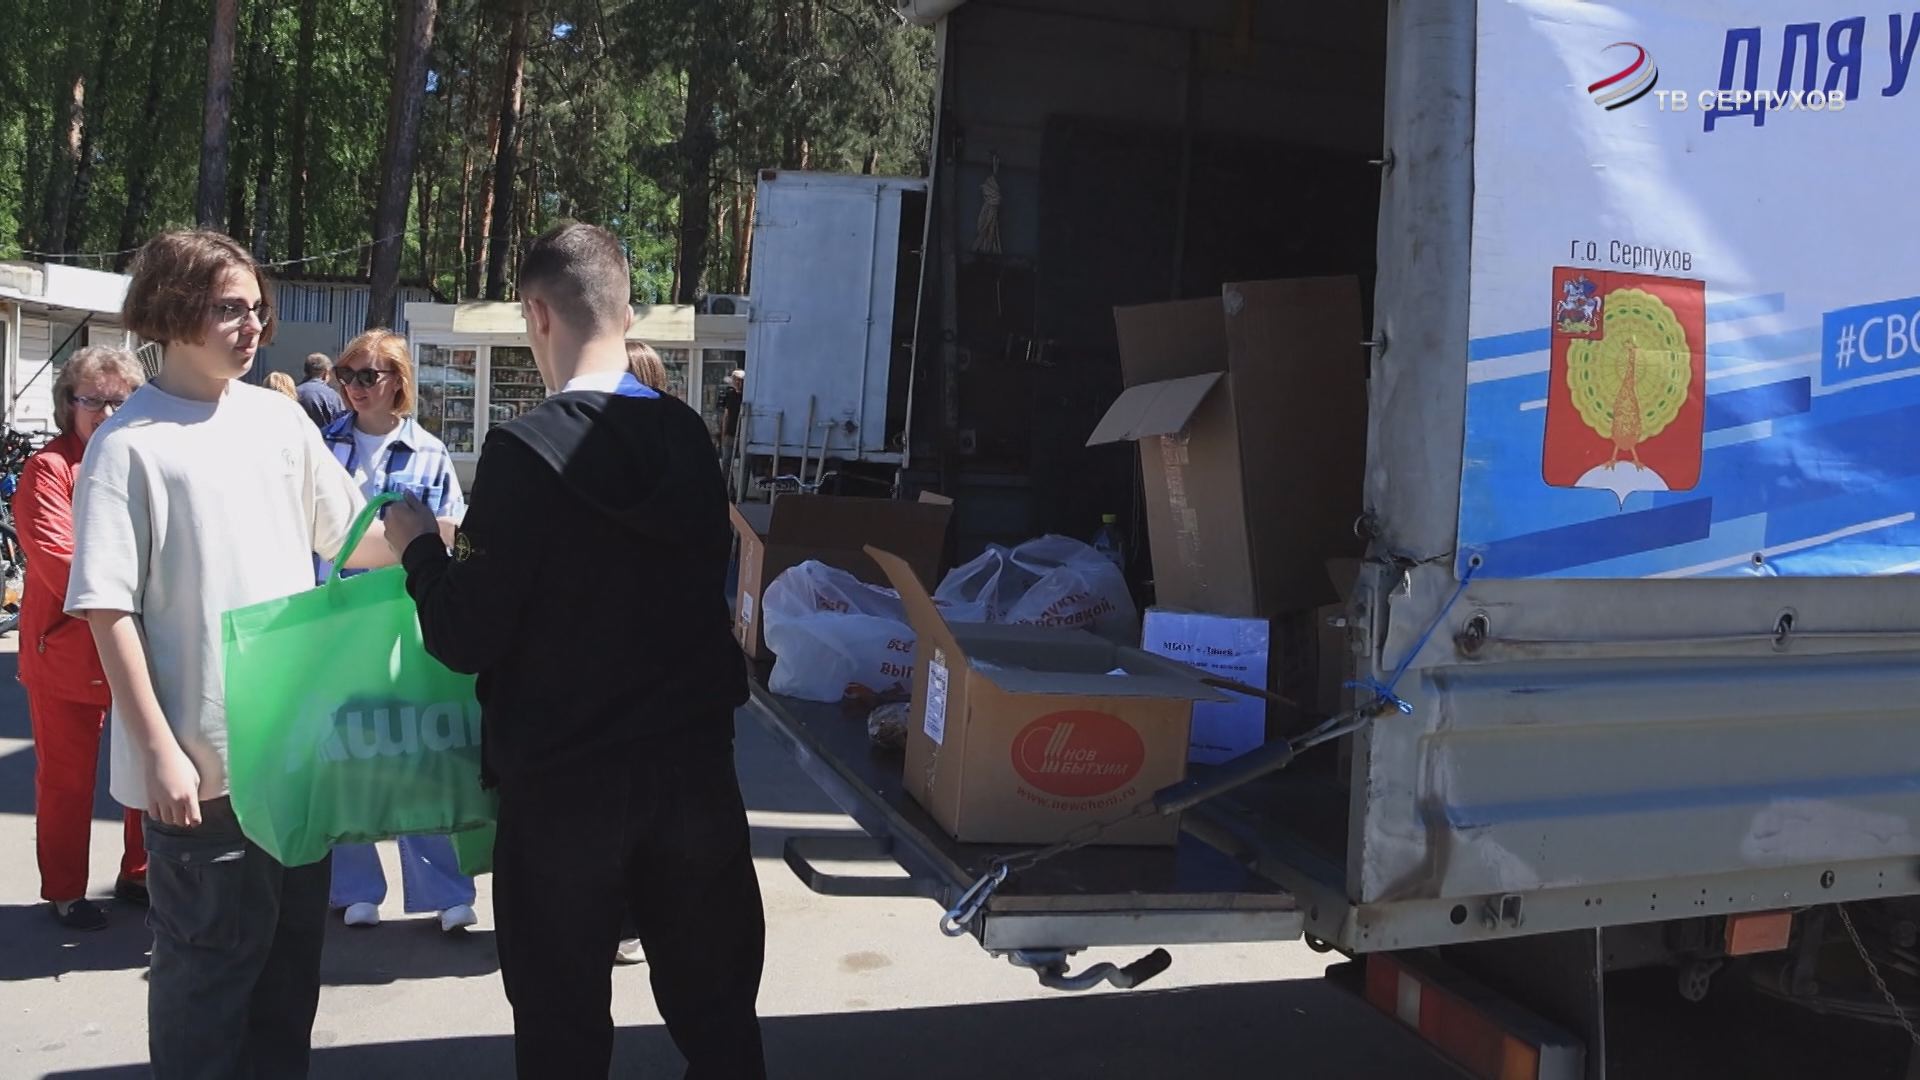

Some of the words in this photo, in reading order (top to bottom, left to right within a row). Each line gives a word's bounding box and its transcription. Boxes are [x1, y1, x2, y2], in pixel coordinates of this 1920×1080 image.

[1703, 16, 1866, 132] ДЛЯ
[1570, 240, 1602, 262] г.о.
[1610, 240, 1692, 271] Серпухов
[1063, 748, 1097, 761] НОВ
[1060, 761, 1129, 776] БЫТХИМ
